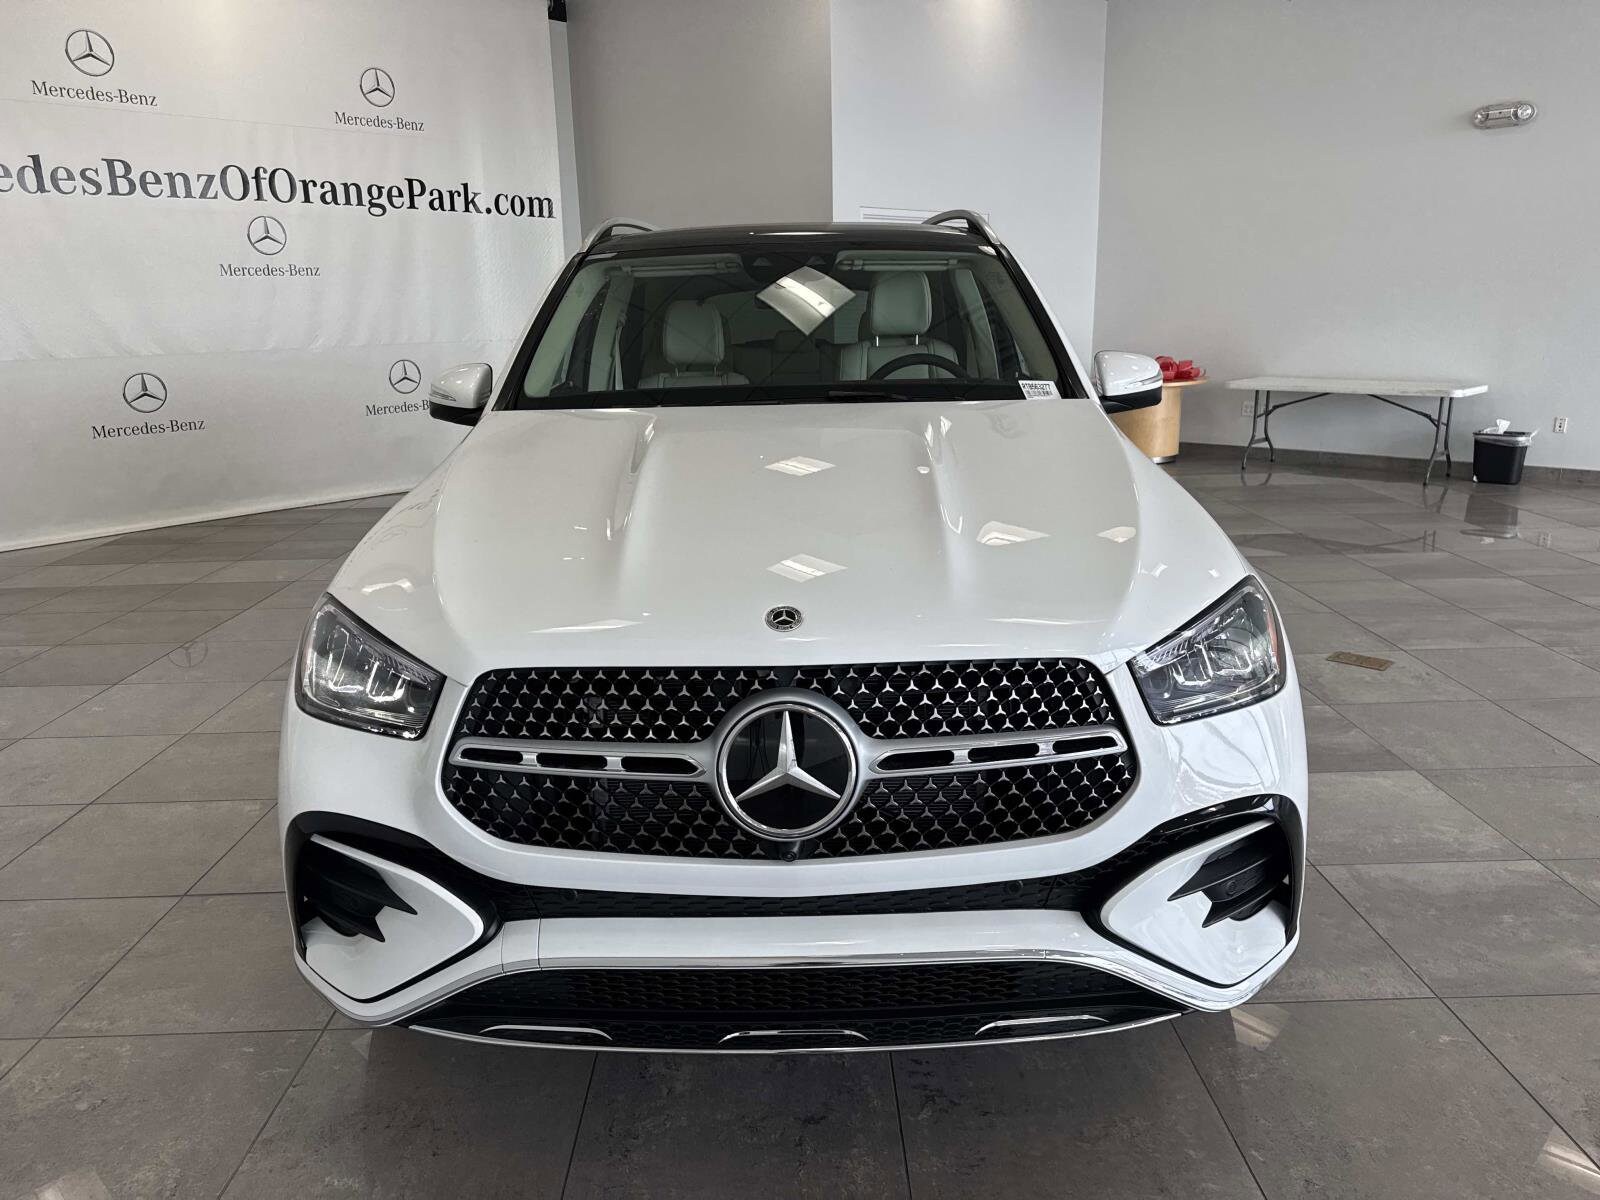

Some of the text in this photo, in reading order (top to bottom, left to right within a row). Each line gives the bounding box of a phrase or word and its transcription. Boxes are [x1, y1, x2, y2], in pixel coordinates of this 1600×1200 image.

[31, 80, 158, 107] Mercedes-Benz
[334, 111, 425, 132] Mercedes-Benz
[219, 263, 321, 278] Mercedes-Benz
[91, 416, 206, 440] Mercedes-Benz
